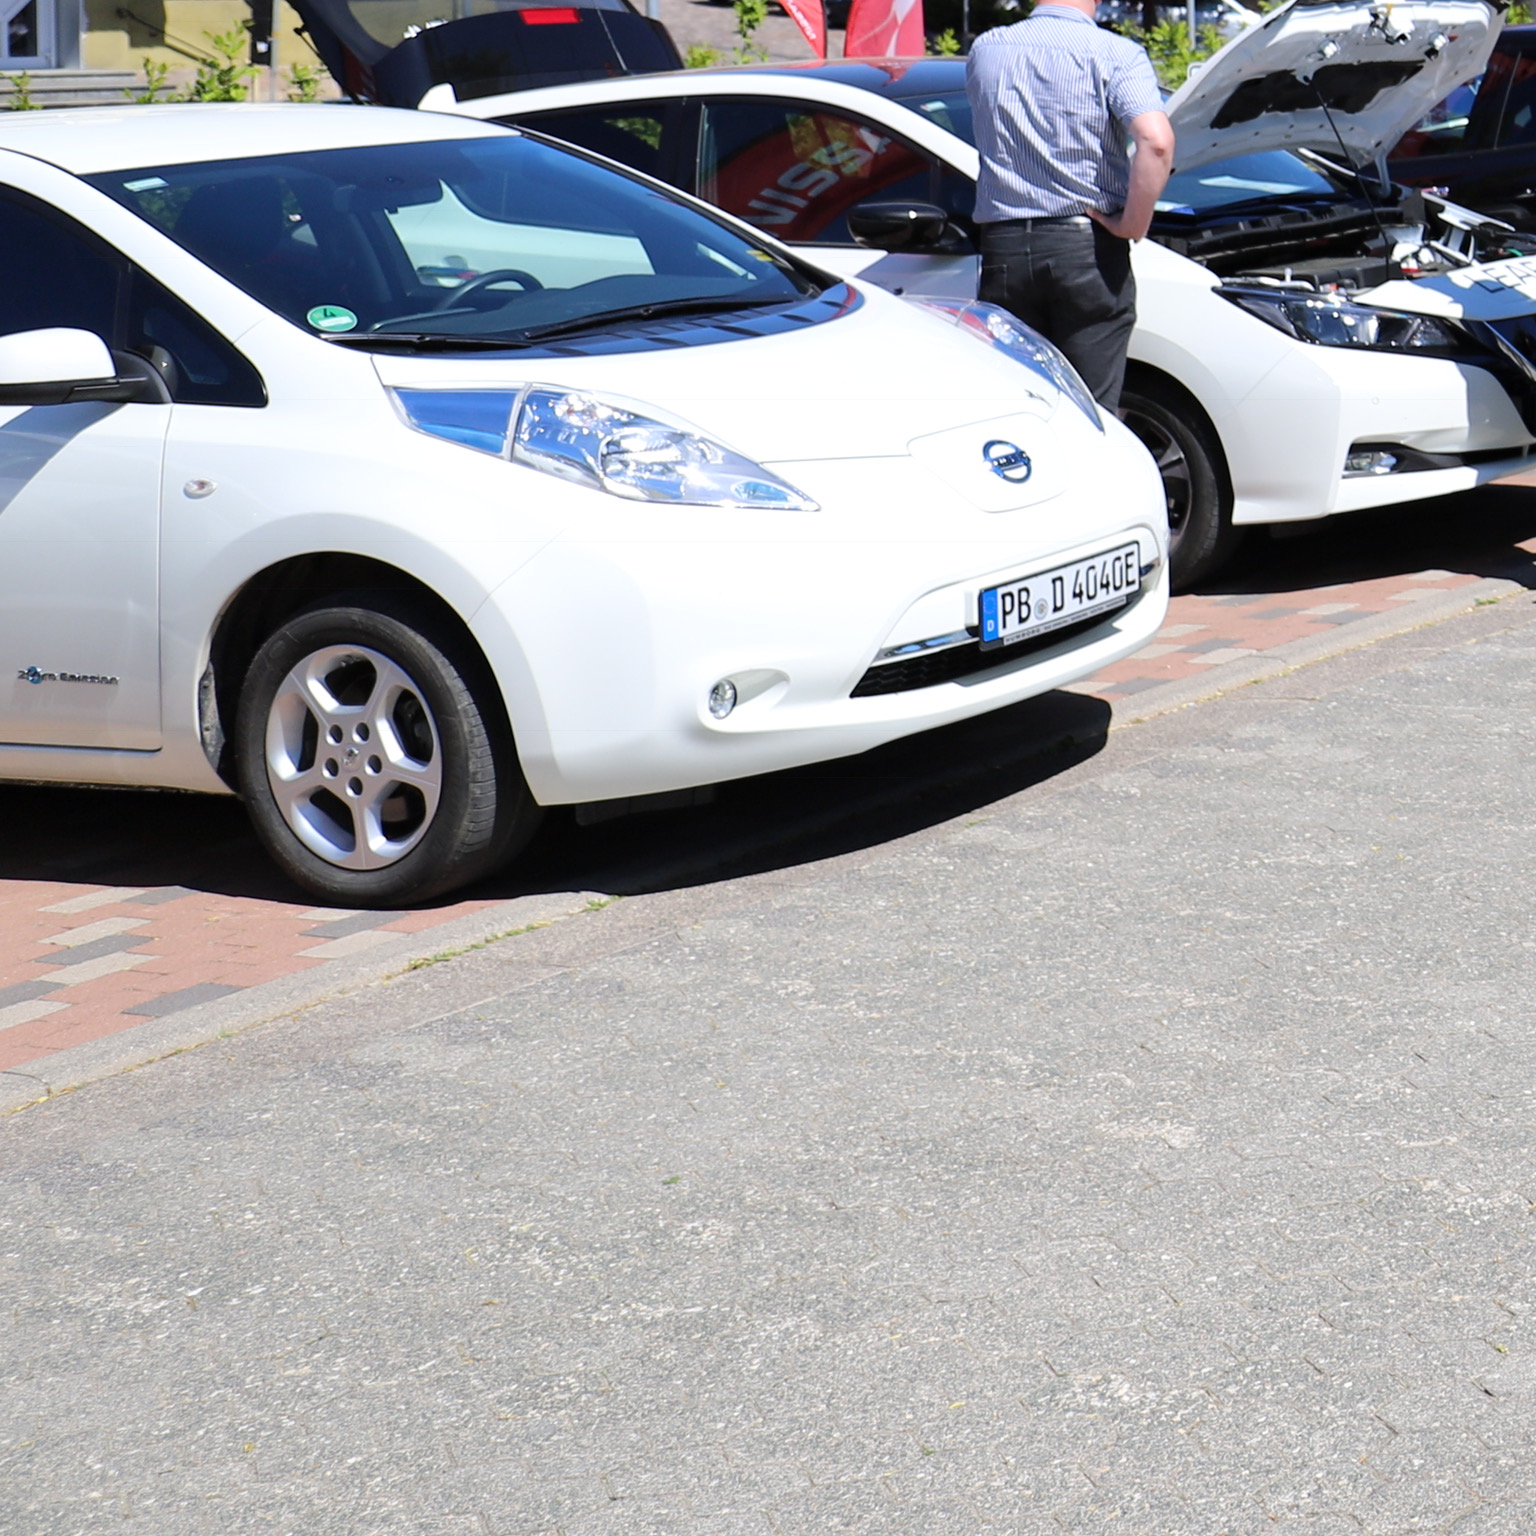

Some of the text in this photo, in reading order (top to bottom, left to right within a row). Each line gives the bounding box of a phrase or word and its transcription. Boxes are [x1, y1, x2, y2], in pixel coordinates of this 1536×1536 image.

[1001, 586, 1032, 629] PB
[1052, 575, 1065, 614] D
[1072, 550, 1136, 605] 4040E
